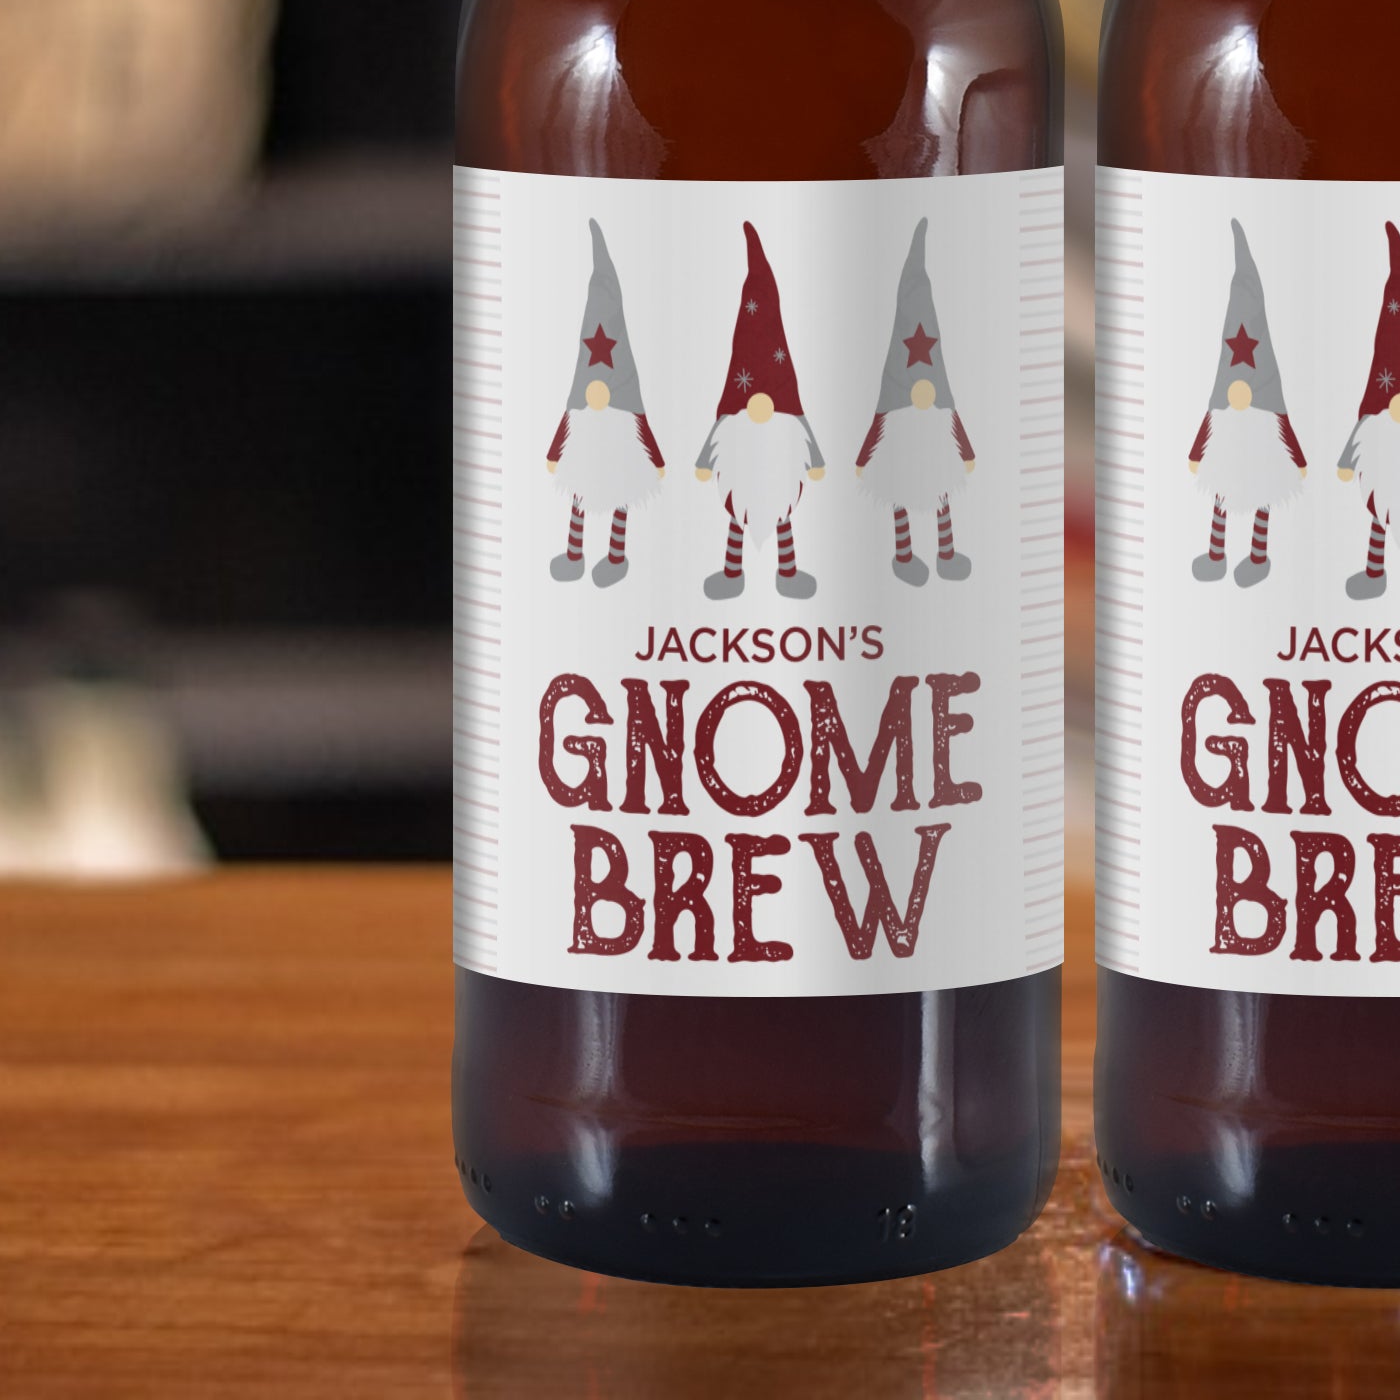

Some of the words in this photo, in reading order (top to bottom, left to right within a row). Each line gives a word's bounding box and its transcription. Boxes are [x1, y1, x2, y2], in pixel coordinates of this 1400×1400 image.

[635, 625, 884, 663] JACKSON'S
[538, 672, 982, 818] GNOME
[567, 823, 951, 964] BREW
